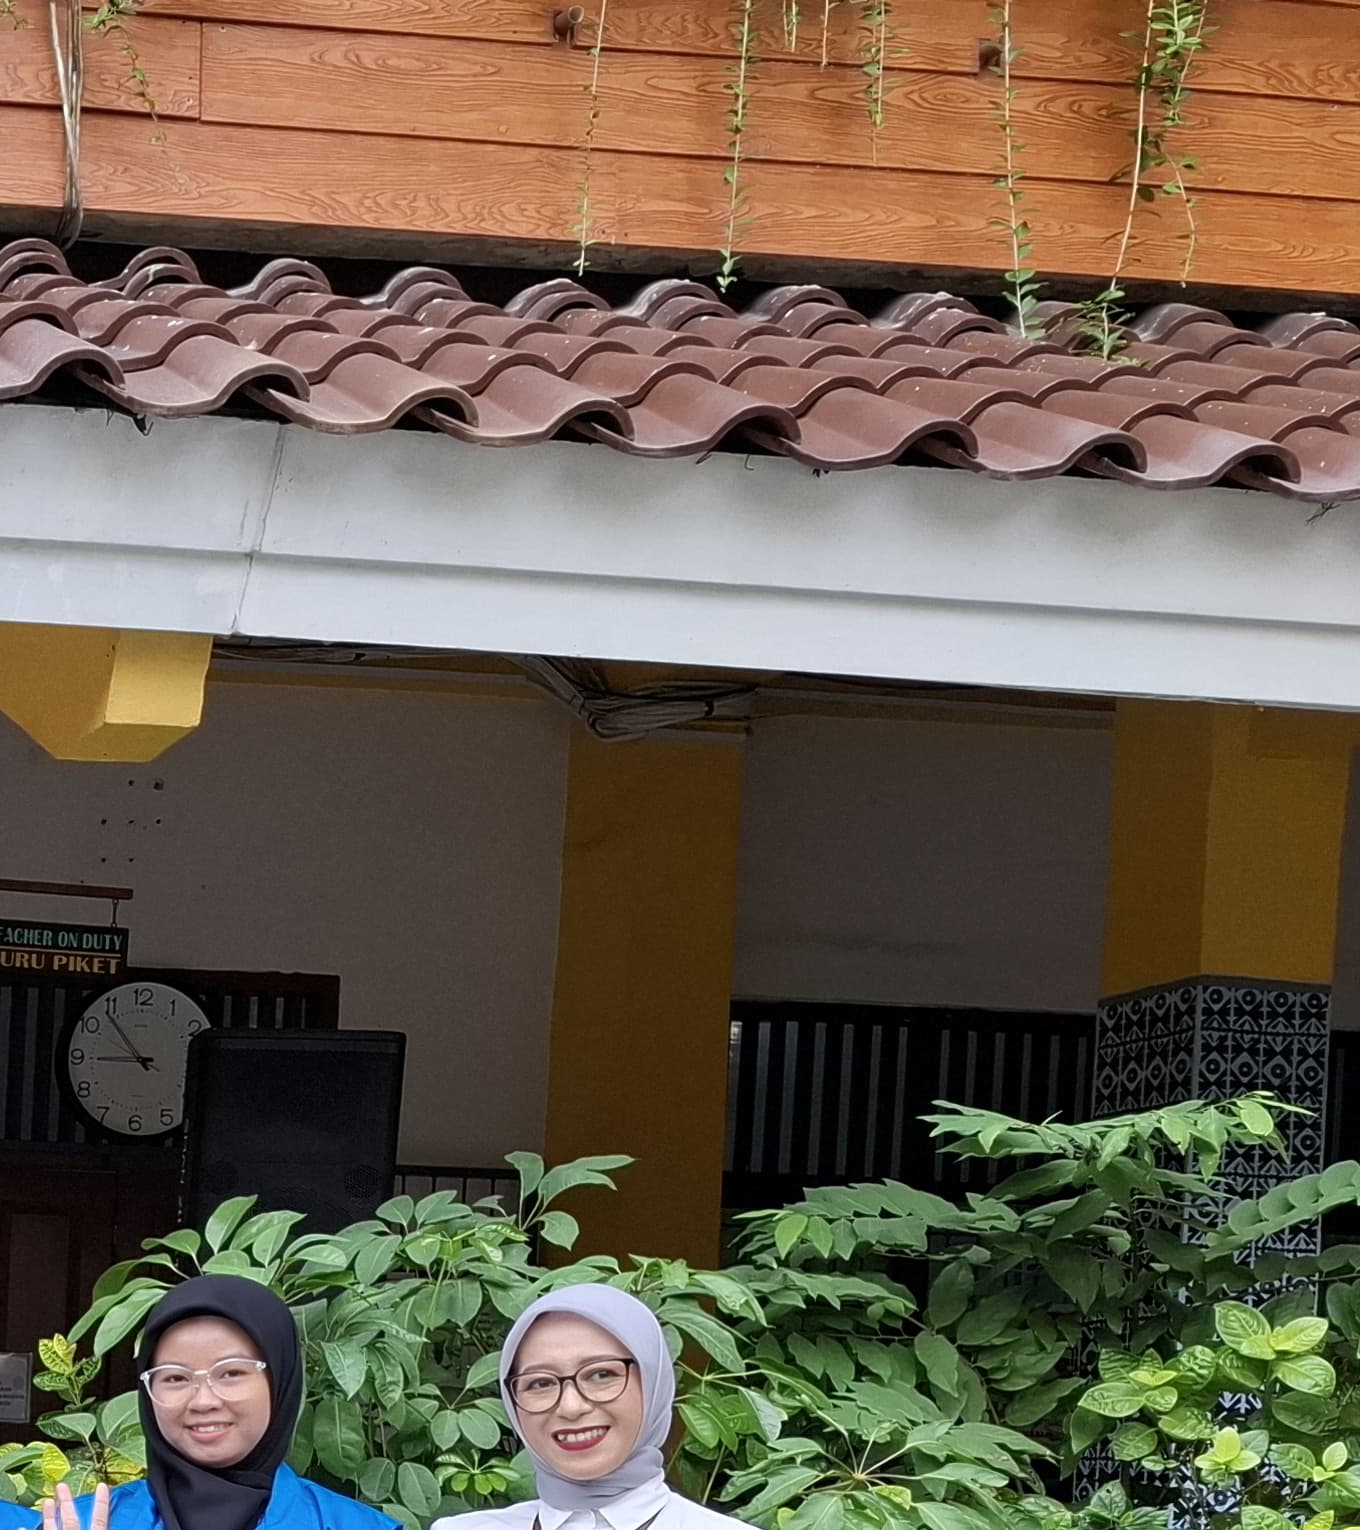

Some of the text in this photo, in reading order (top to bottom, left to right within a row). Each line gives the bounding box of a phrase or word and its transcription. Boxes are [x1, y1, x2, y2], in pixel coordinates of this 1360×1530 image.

[58, 931, 79, 948] ON
[82, 933, 123, 950] DUTY
[53, 955, 121, 975] PIKET
[105, 997, 117, 1015] 11
[134, 988, 154, 1006] 12
[169, 999, 176, 1016] 1
[80, 1016, 100, 1033] 10
[187, 1019, 202, 1037] 2
[70, 1048, 85, 1065] 9
[77, 1081, 91, 1098] 8
[96, 1106, 110, 1124] 7
[128, 1114, 143, 1132] 6
[160, 1108, 174, 1126] 5
